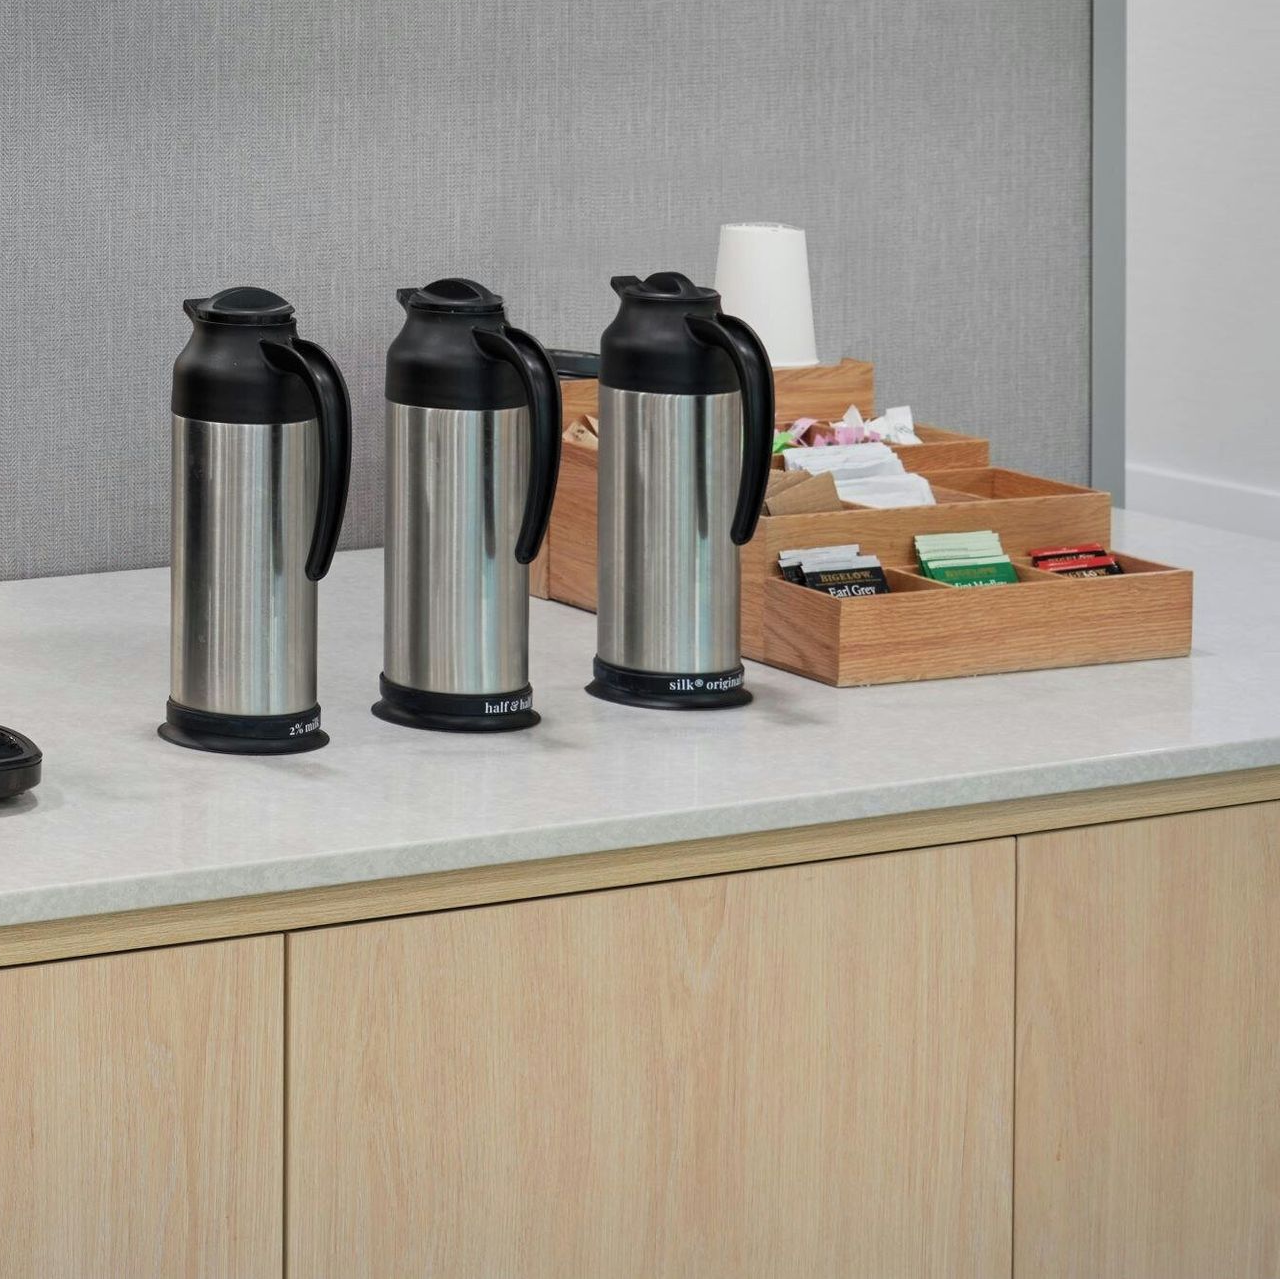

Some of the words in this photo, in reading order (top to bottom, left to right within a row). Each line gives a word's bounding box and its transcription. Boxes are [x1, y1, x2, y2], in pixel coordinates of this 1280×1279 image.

[819, 570, 872, 583] BIGELOW
[828, 585, 852, 599] Earl
[851, 584, 877, 597] Grey
[485, 700, 510, 714] half
[510, 700, 520, 712] &
[289, 722, 304, 736] 2%
